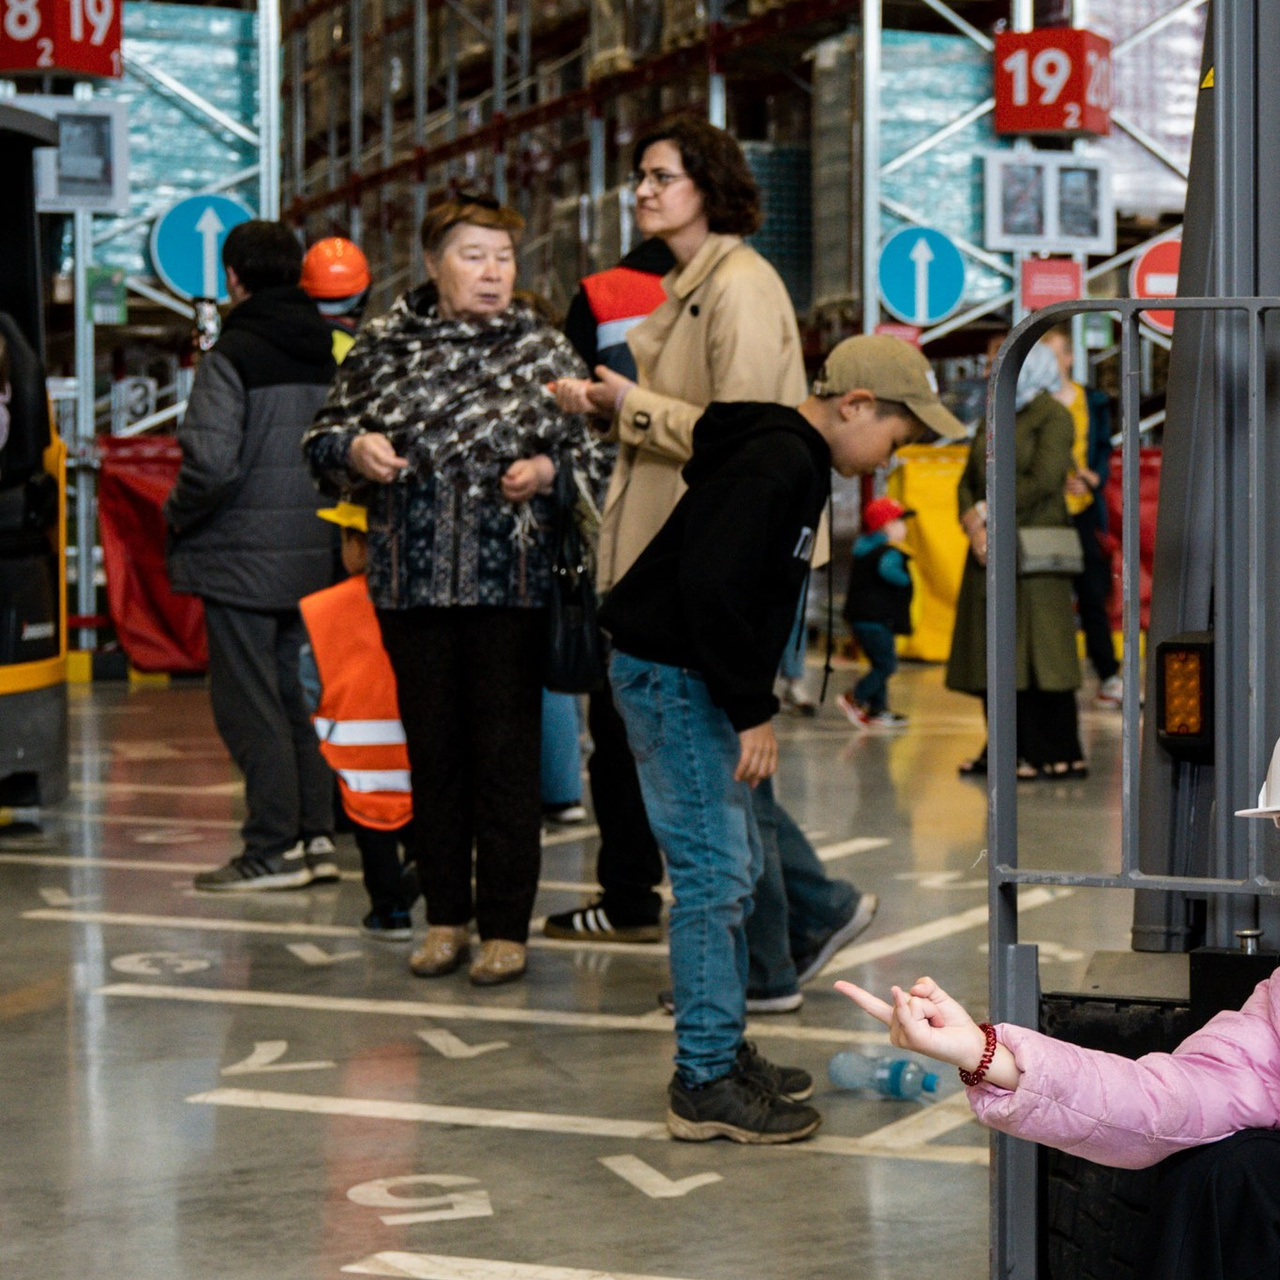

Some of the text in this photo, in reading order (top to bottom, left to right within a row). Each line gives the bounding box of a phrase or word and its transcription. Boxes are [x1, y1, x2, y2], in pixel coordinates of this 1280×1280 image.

[36, 37, 55, 68] 2
[1003, 48, 1071, 106] 19
[1062, 102, 1081, 130] 2
